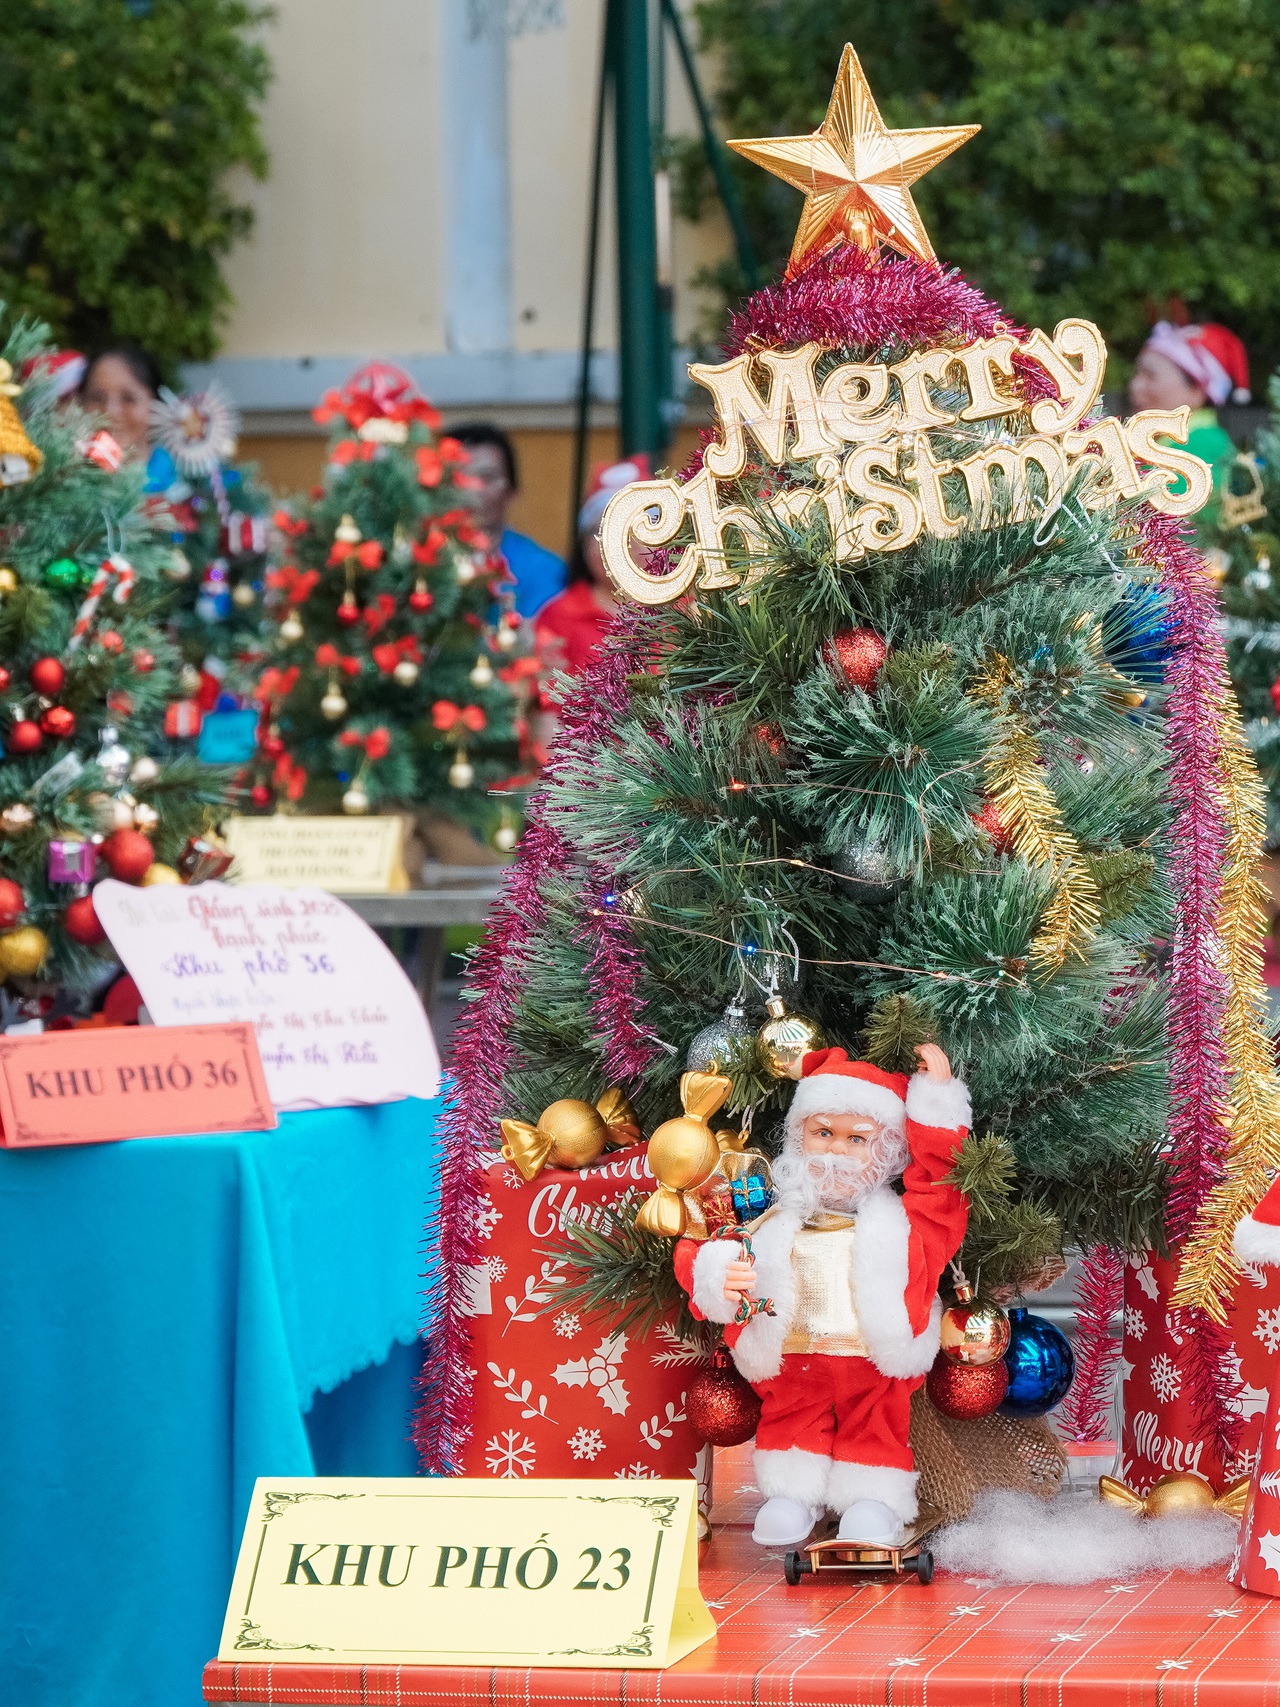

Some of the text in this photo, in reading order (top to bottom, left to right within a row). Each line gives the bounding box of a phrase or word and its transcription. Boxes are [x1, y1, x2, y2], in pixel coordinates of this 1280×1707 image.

[688, 317, 1108, 477] Merry
[599, 404, 1214, 606] Christmas
[303, 953, 335, 974] 36
[26, 1053, 238, 1099] KHU PHỐ 36
[1133, 1410, 1209, 1481] Merry
[280, 1532, 632, 1592] KHU PHỐ 23
